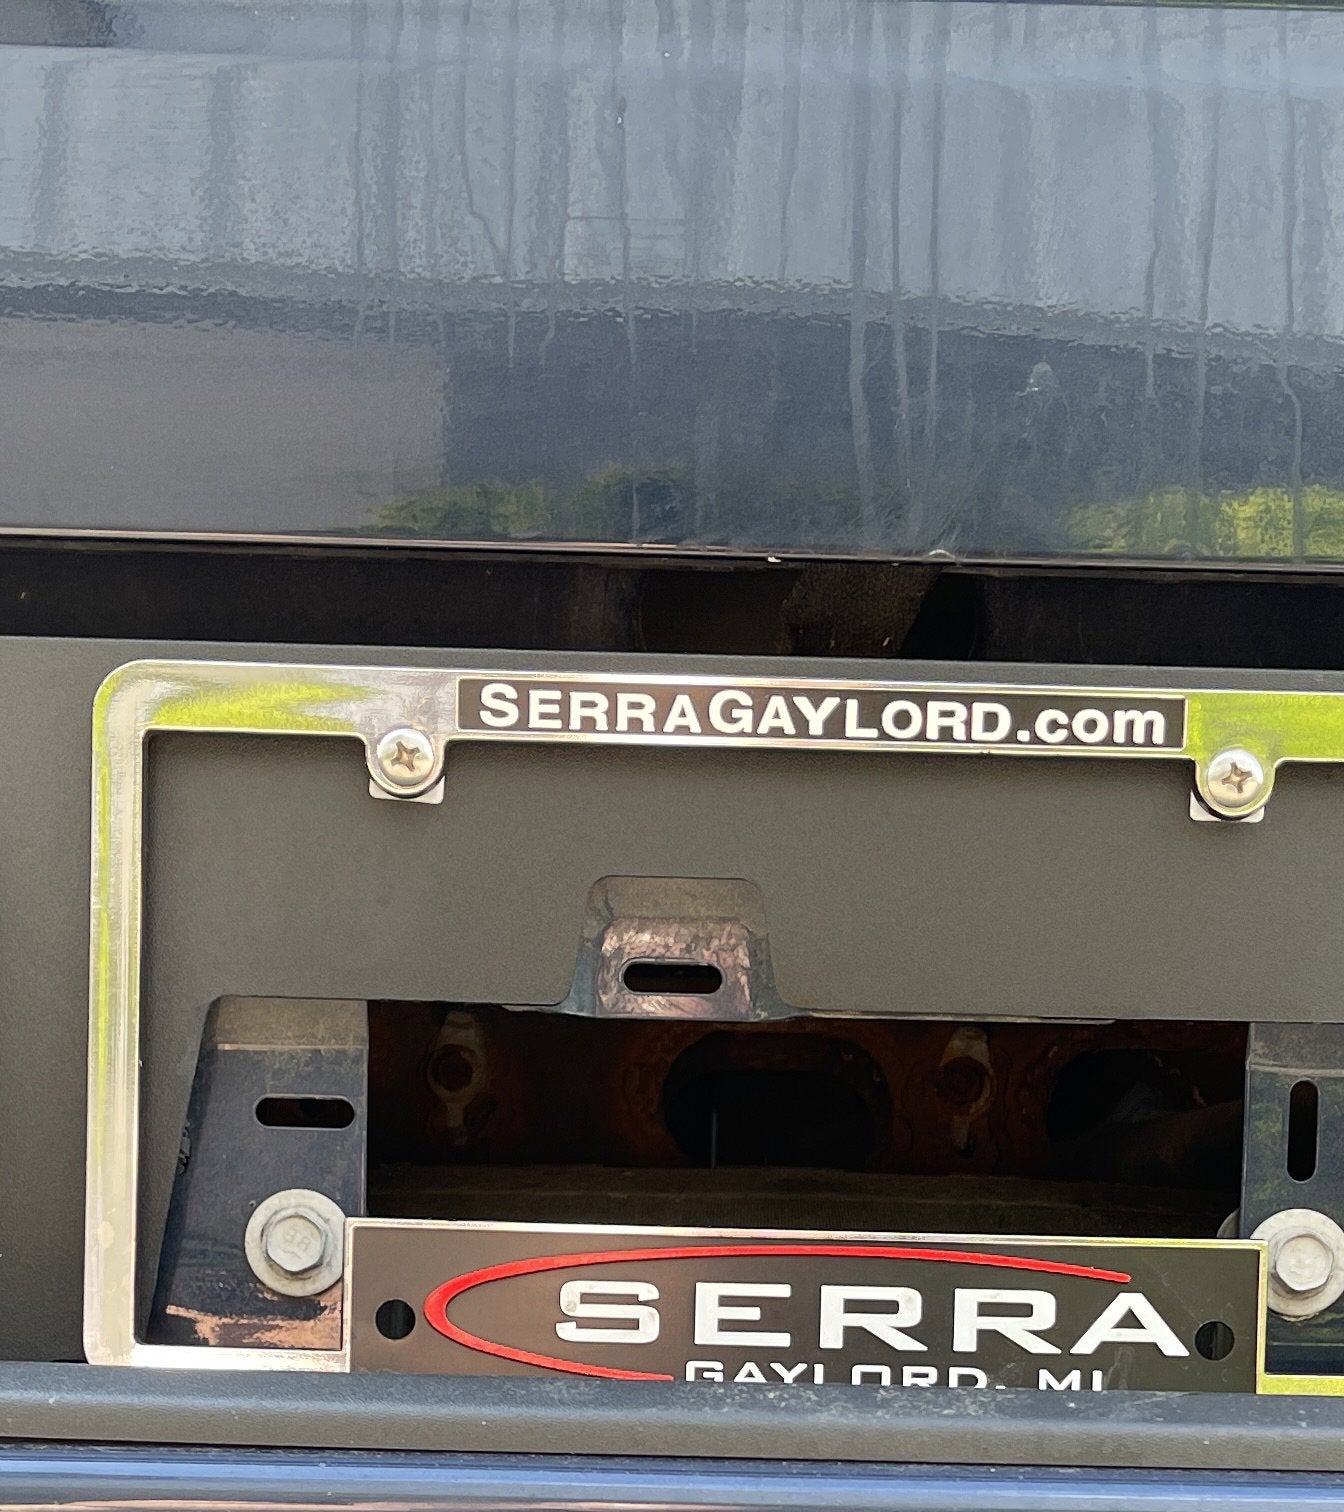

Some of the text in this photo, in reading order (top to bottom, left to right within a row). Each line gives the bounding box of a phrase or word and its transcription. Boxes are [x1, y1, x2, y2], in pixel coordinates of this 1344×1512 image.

[478, 682, 1166, 745] SERRAGAYLORD.com
[555, 1279, 1190, 1357] SERRA
[1037, 1367, 1104, 1392] MI
